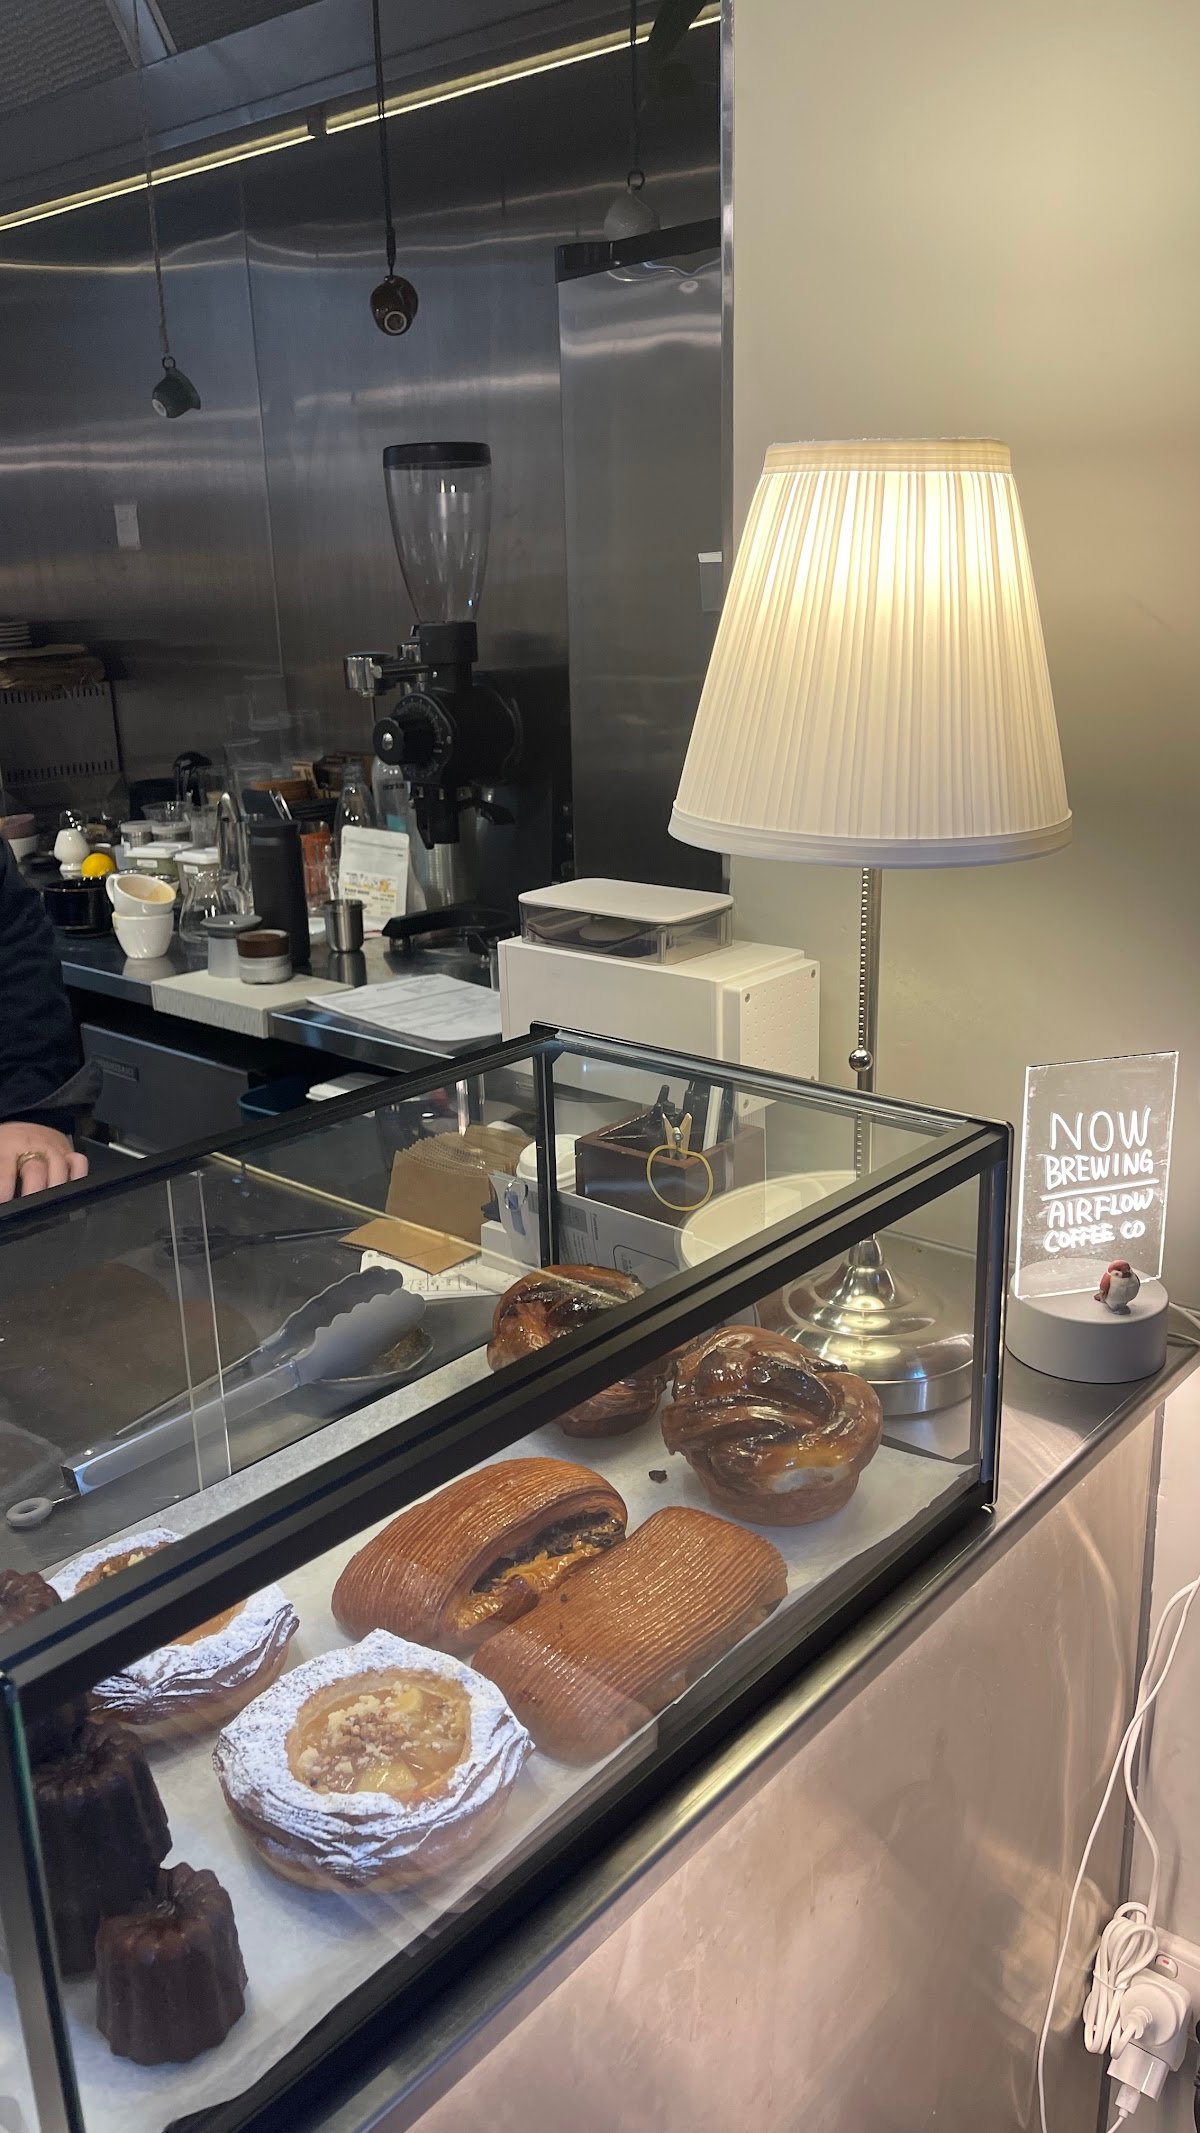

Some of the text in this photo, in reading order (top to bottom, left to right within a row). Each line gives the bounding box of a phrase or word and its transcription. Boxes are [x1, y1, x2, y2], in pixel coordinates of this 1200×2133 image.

[1050, 1106, 1151, 1152] NOW
[1045, 1149, 1154, 1190] BREWING
[1048, 1188, 1154, 1229] AIRFLOW
[1043, 1219, 1146, 1253] COFFEE CO
